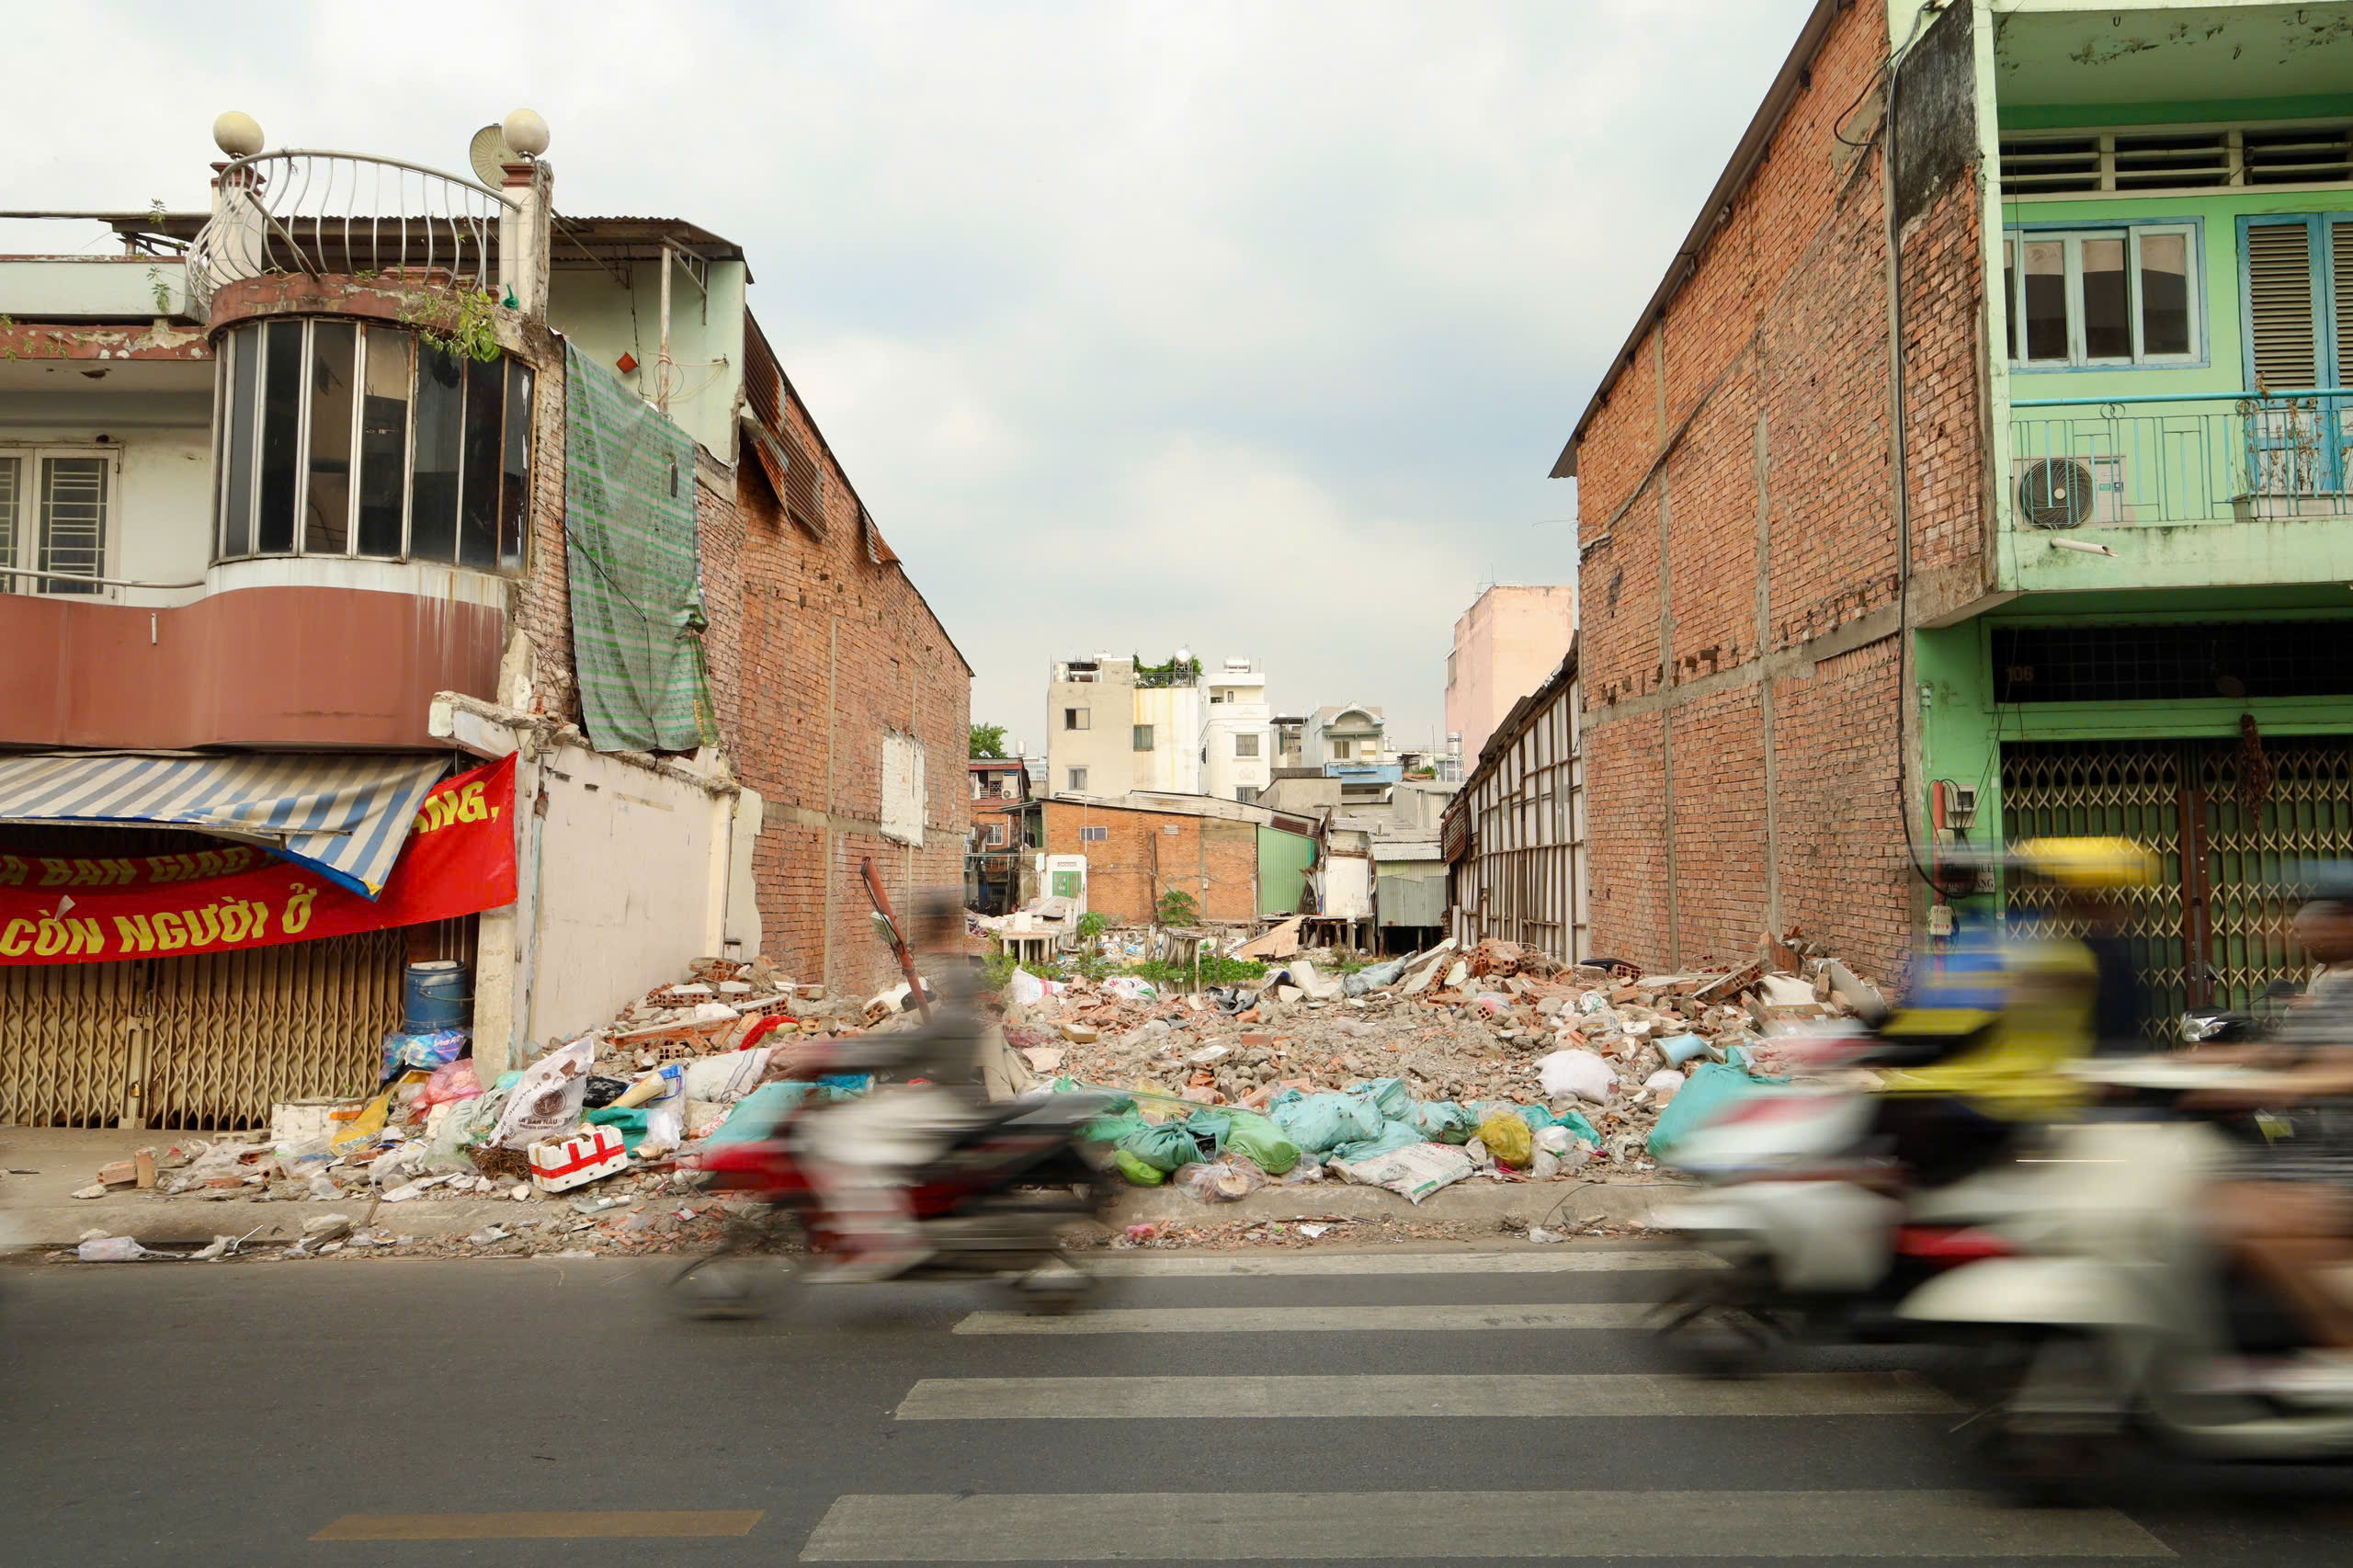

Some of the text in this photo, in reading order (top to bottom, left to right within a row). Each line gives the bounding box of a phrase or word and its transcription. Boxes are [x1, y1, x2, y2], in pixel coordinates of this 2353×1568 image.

[0, 882, 317, 957] CÒN NGƯỜI Ở
